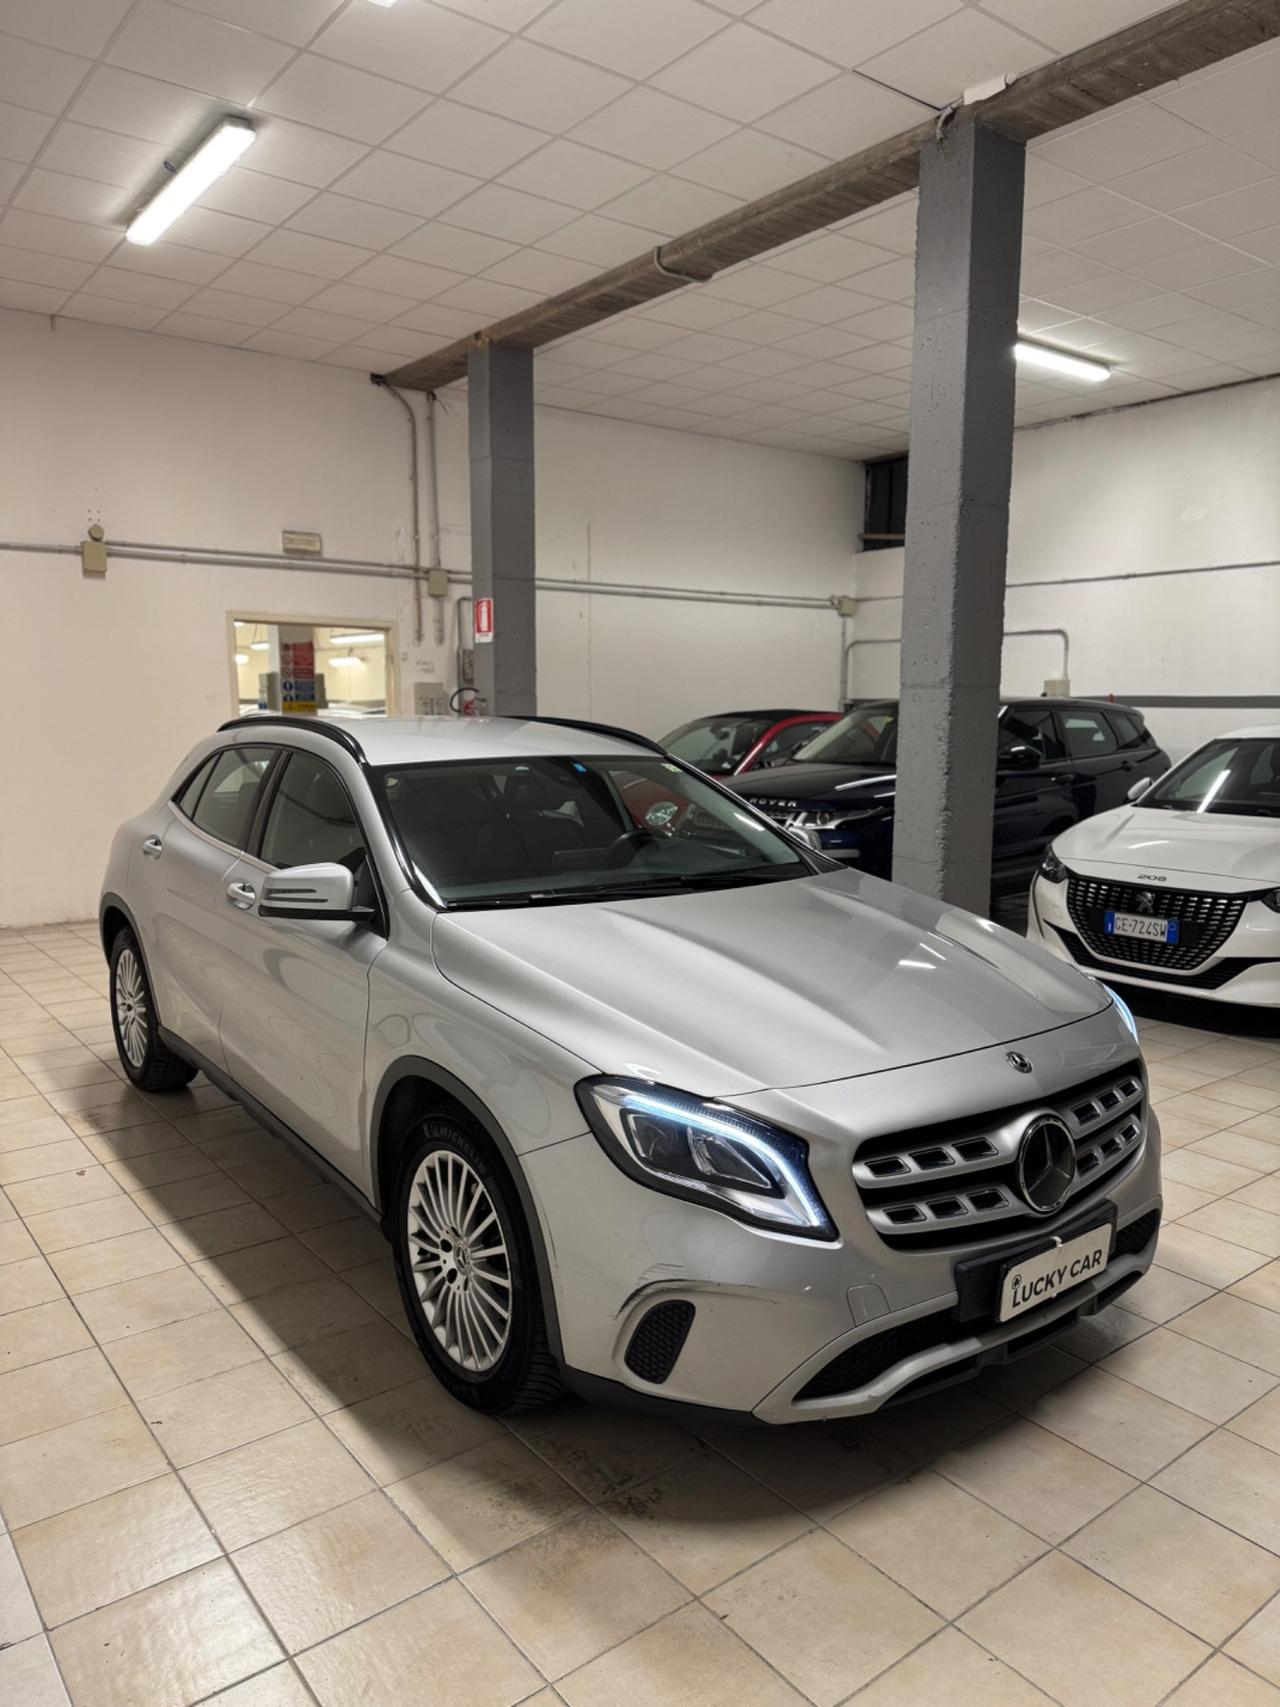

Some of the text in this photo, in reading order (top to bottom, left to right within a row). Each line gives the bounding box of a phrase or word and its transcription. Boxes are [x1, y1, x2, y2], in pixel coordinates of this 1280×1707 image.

[750, 797, 798, 808] ROVER
[1137, 874, 1168, 882] 208
[1012, 1248, 1103, 1309] LUCKY CAR
